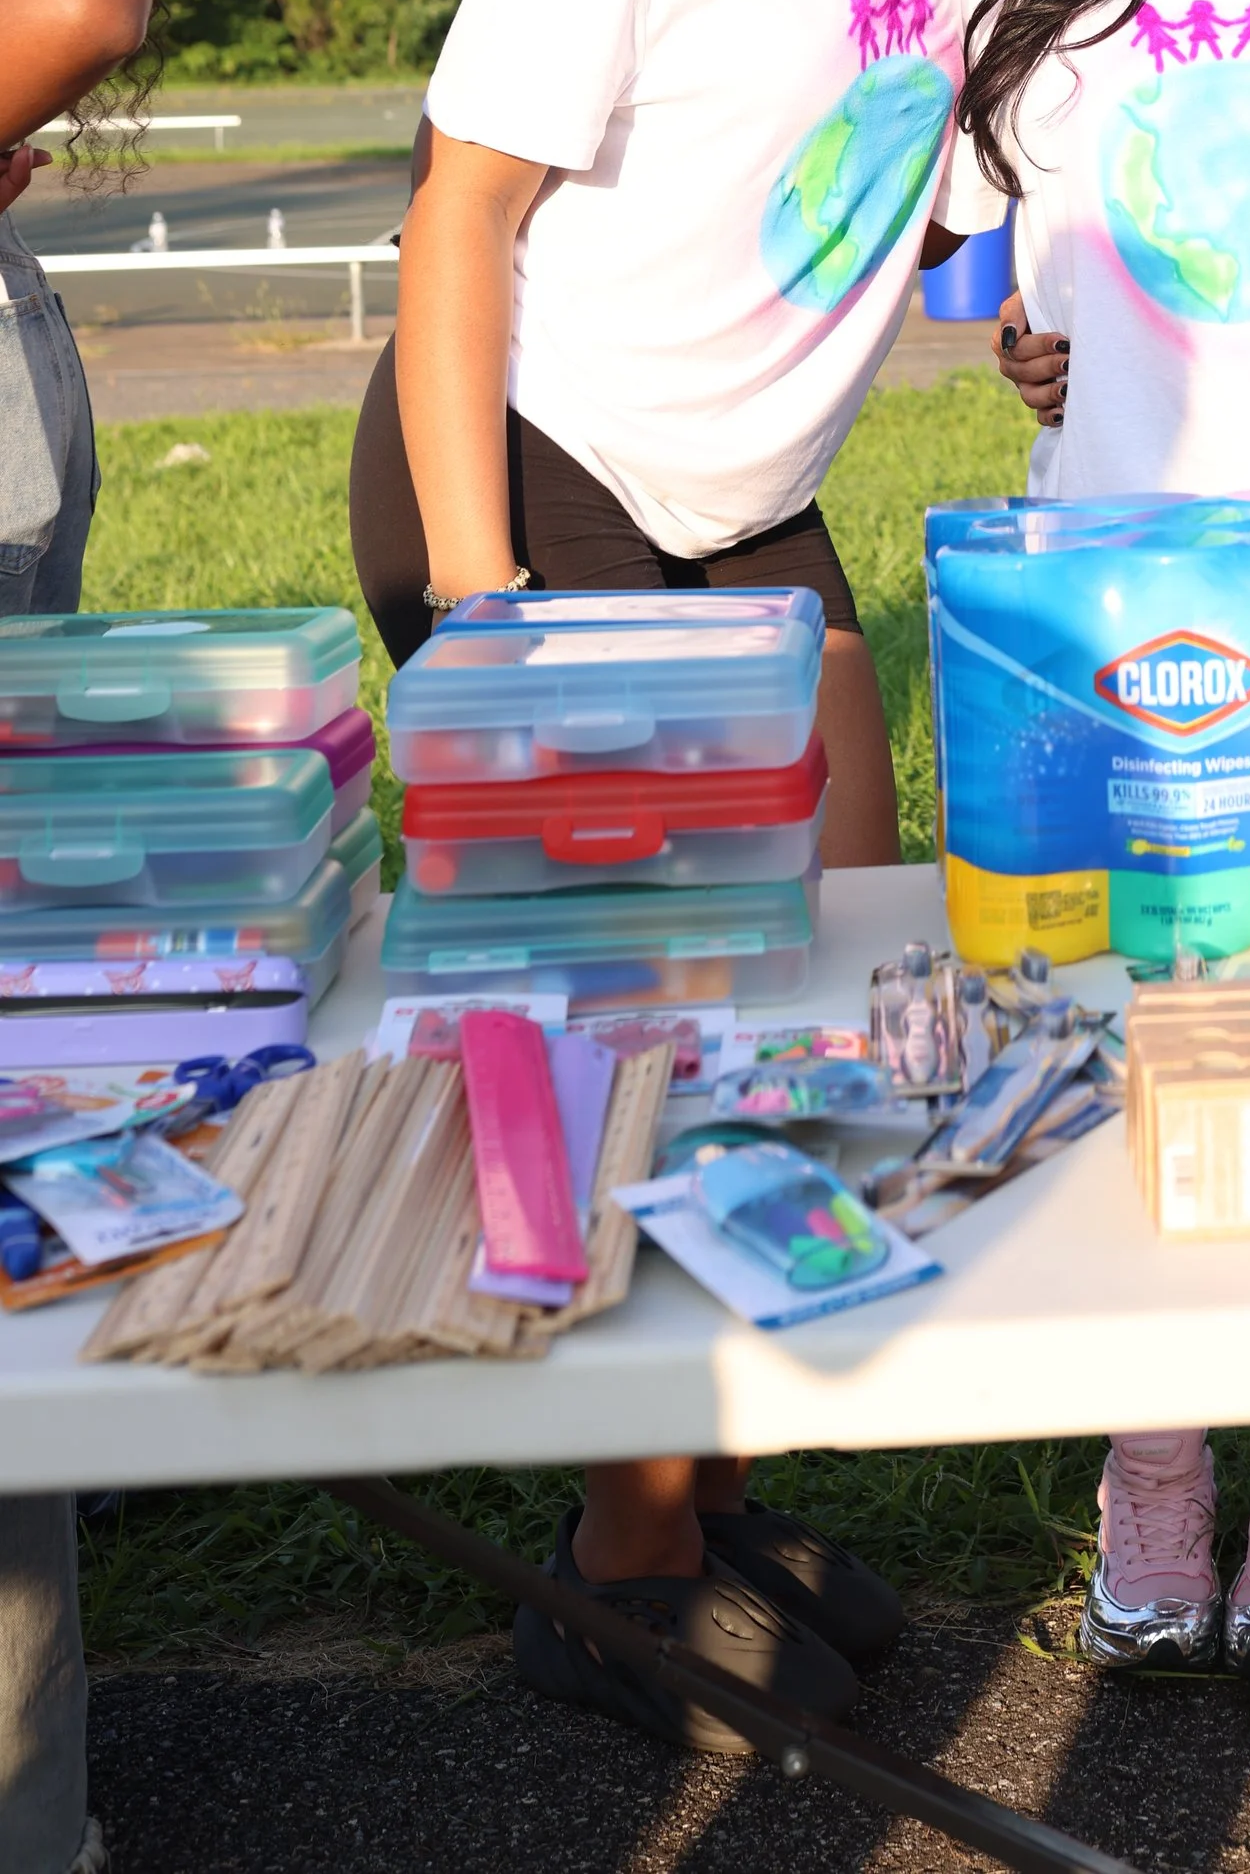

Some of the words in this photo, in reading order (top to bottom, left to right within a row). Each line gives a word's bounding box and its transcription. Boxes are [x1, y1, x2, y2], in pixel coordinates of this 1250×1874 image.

[1117, 659, 1248, 707] CLOROX
[1111, 755, 1202, 778] Disinfecting
[1113, 783, 1150, 800] KILLS
[1203, 797, 1216, 813] 24
